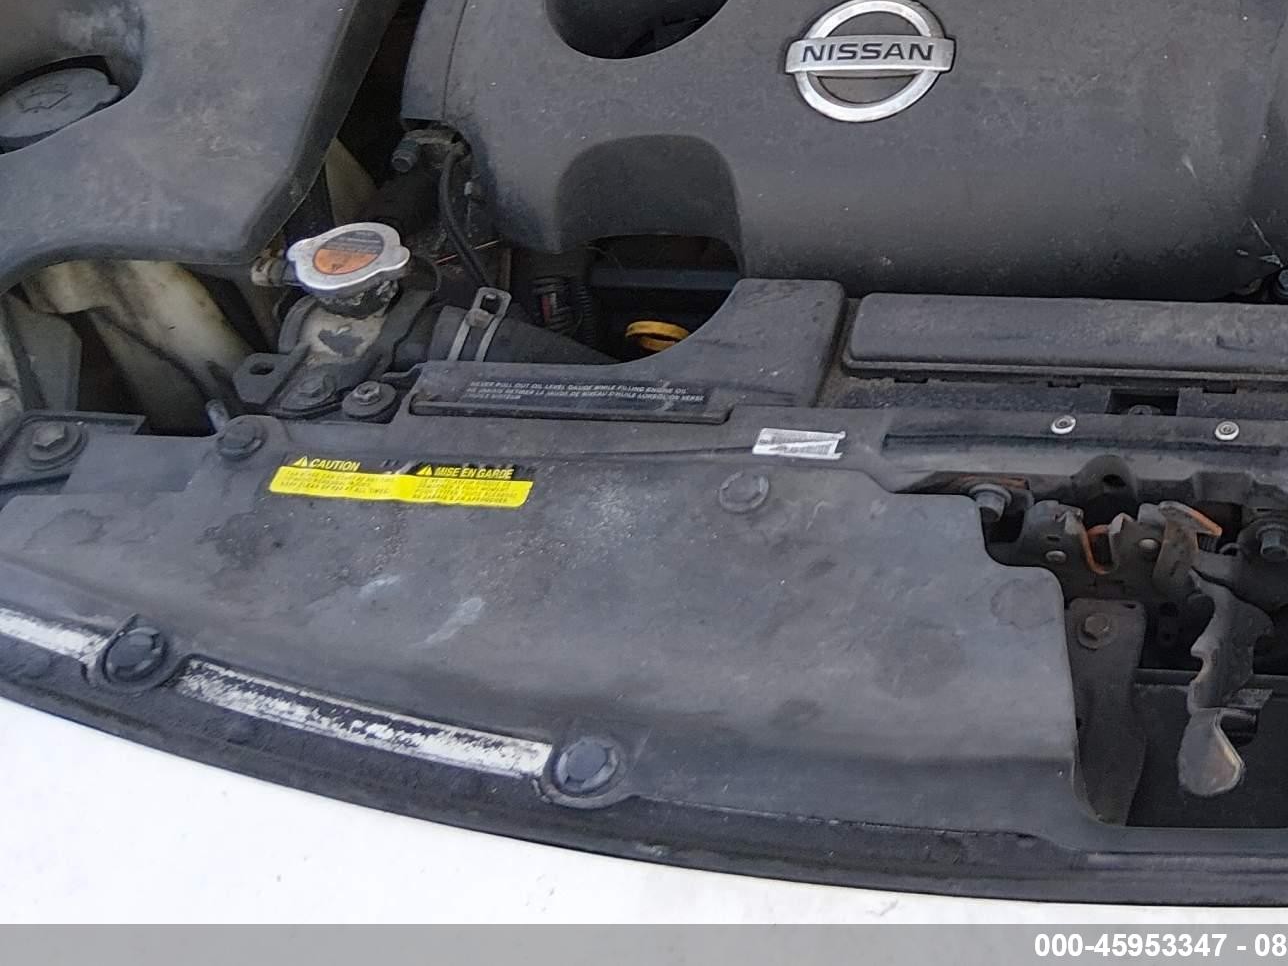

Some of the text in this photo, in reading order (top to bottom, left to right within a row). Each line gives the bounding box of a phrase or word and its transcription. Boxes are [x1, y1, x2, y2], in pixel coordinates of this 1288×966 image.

[802, 43, 934, 62] NISSAN
[308, 458, 361, 472] CAUTION
[433, 467, 515, 480] MISE EN GARDE
